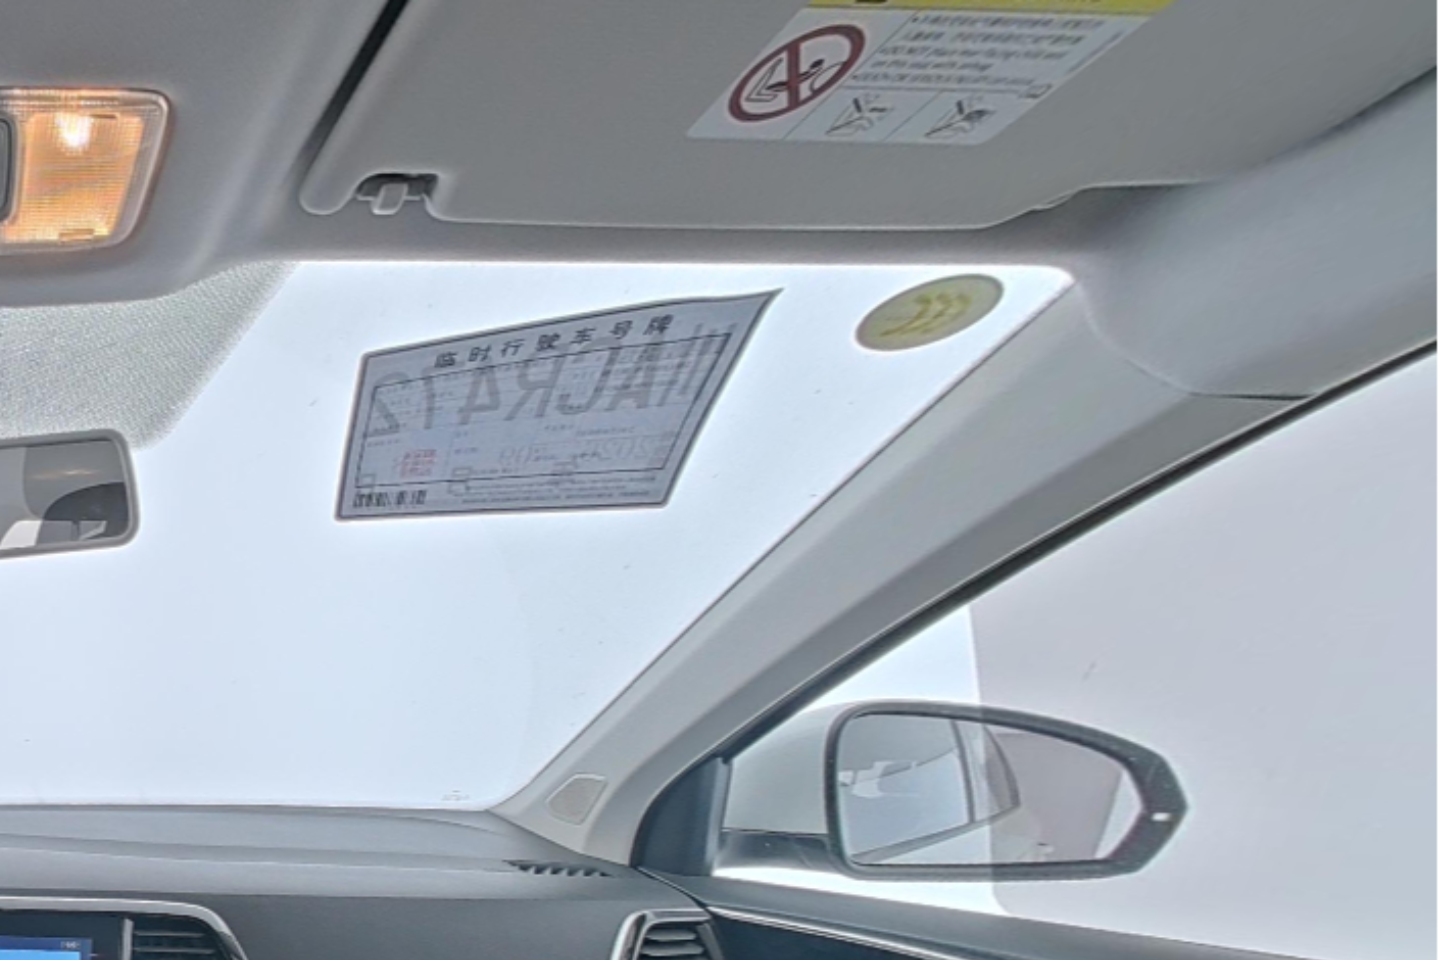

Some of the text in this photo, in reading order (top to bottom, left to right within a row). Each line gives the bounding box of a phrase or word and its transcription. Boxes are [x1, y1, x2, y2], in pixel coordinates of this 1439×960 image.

[434, 314, 674, 368] 临时行驶车号牌
